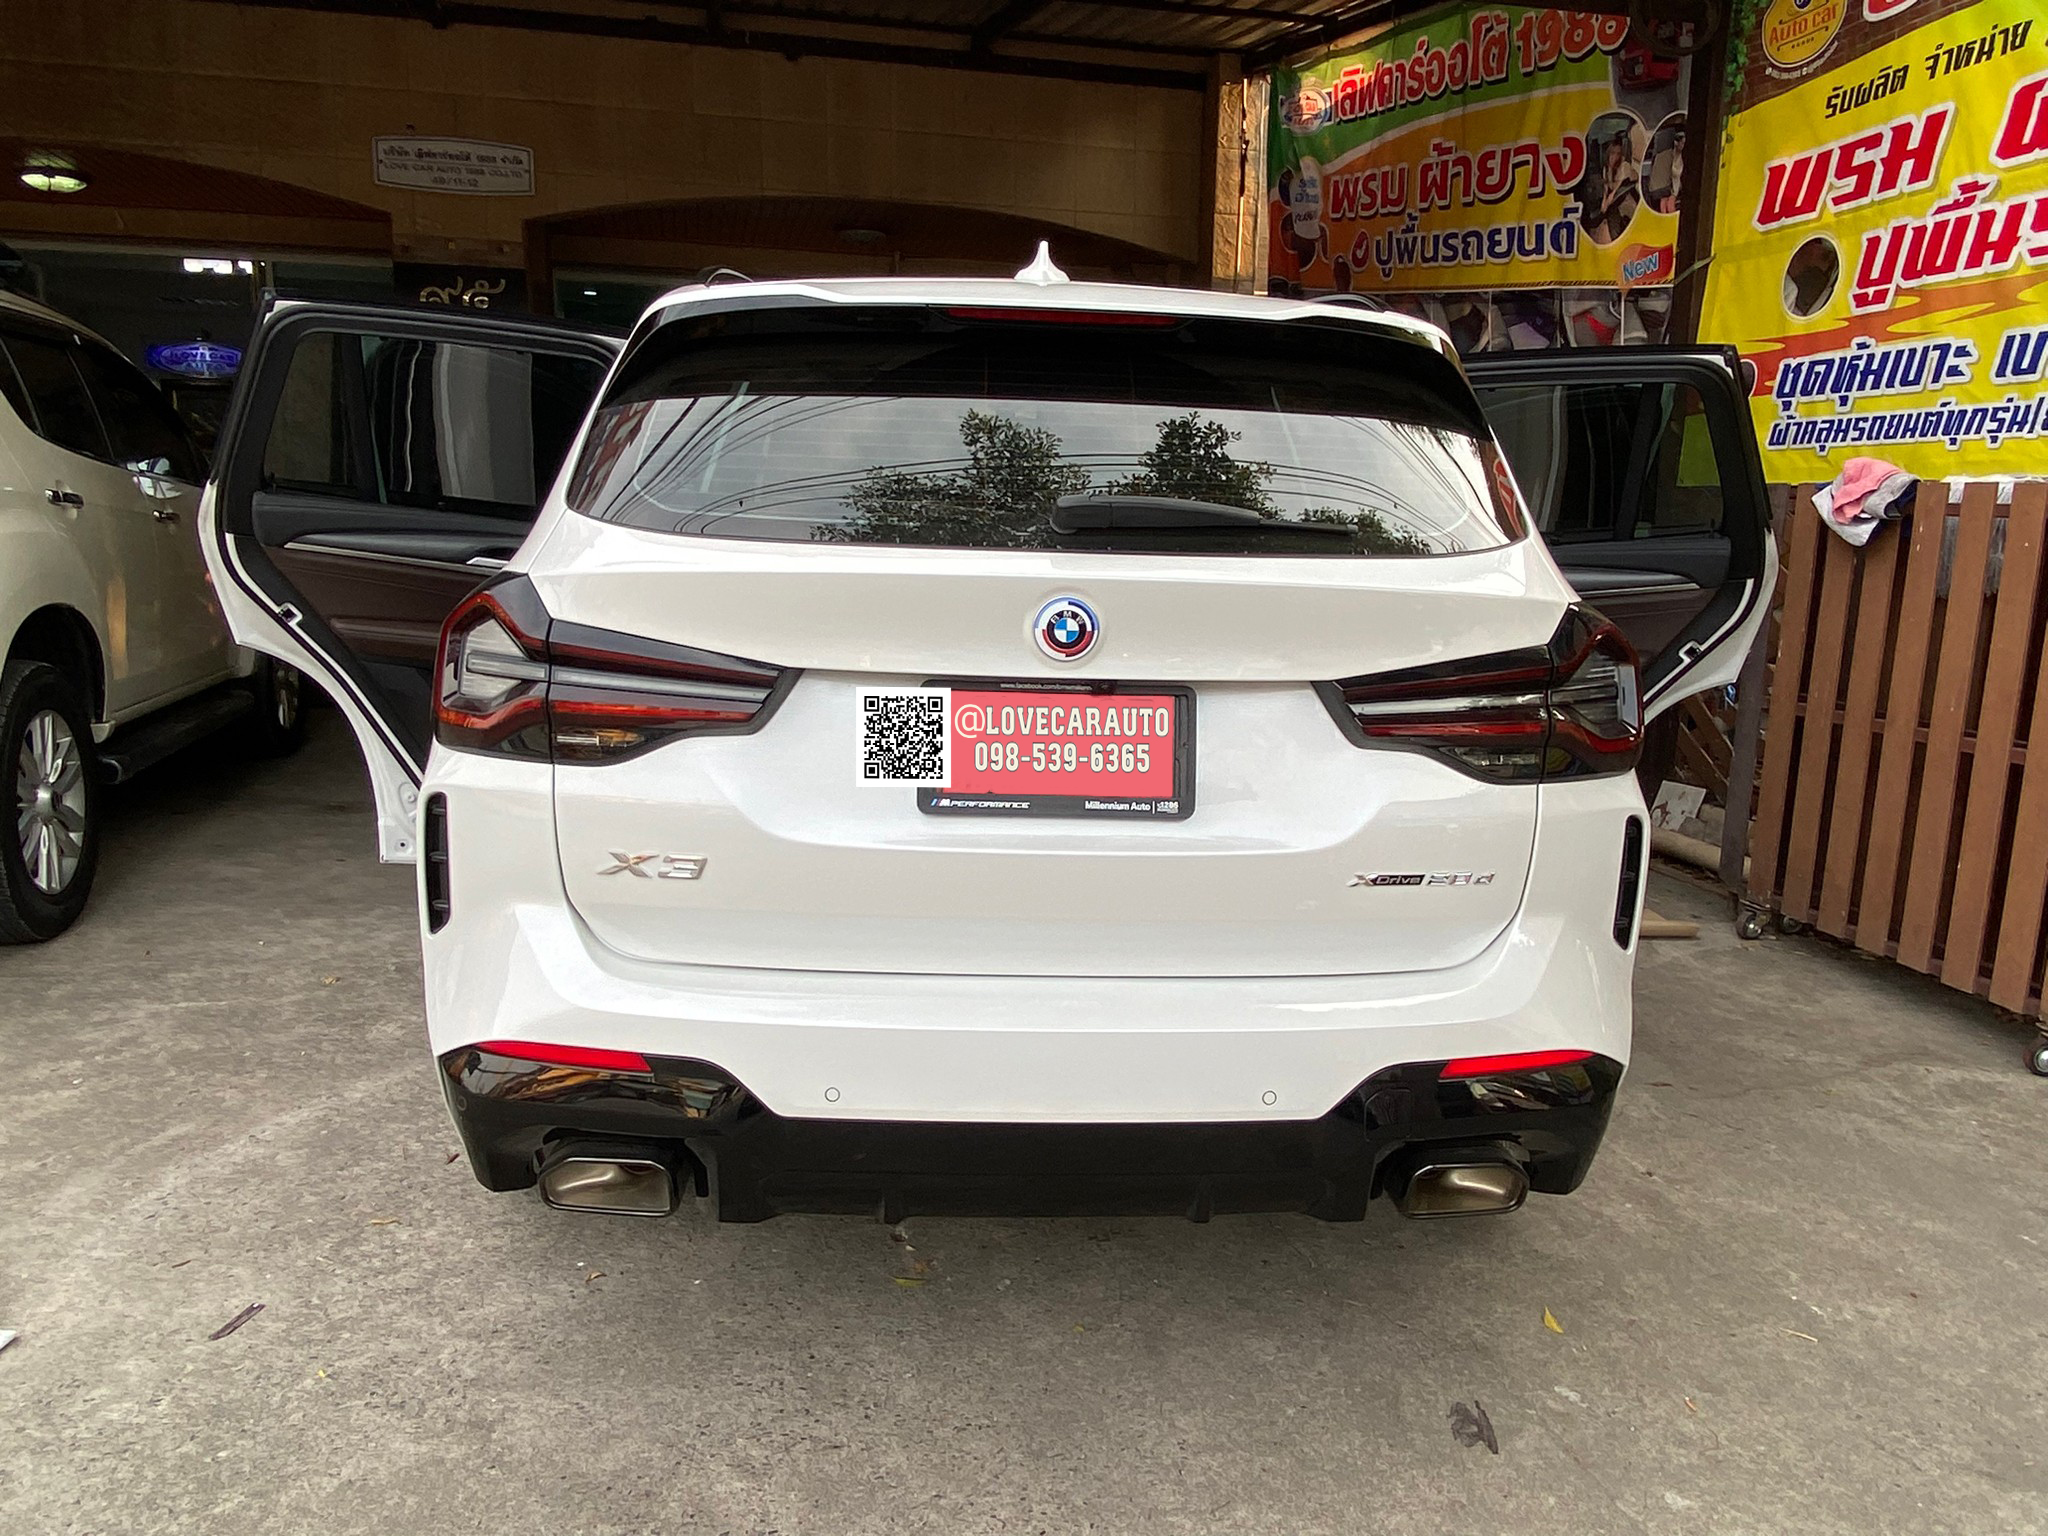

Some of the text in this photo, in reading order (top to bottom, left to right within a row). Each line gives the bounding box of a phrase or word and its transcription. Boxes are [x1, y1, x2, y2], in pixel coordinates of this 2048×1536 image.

[1769, 18, 1808, 46] Auto
[1925, 20, 2034, 80] จำหน่าย
[1331, 166, 1408, 218] พรม
[1417, 135, 1586, 211] ผ้ายาง
[1755, 104, 1952, 229] พรม
[1375, 204, 1581, 279] ปูพื้นรถยนต์
[1622, 252, 1660, 282] New
[1775, 339, 1974, 413] ชุดหุ้มเบาะ
[1050, 611, 1084, 625] BMW
[1085, 801, 1129, 810] Millennium
[1131, 802, 1151, 811] Auto
[596, 848, 709, 880] X3
